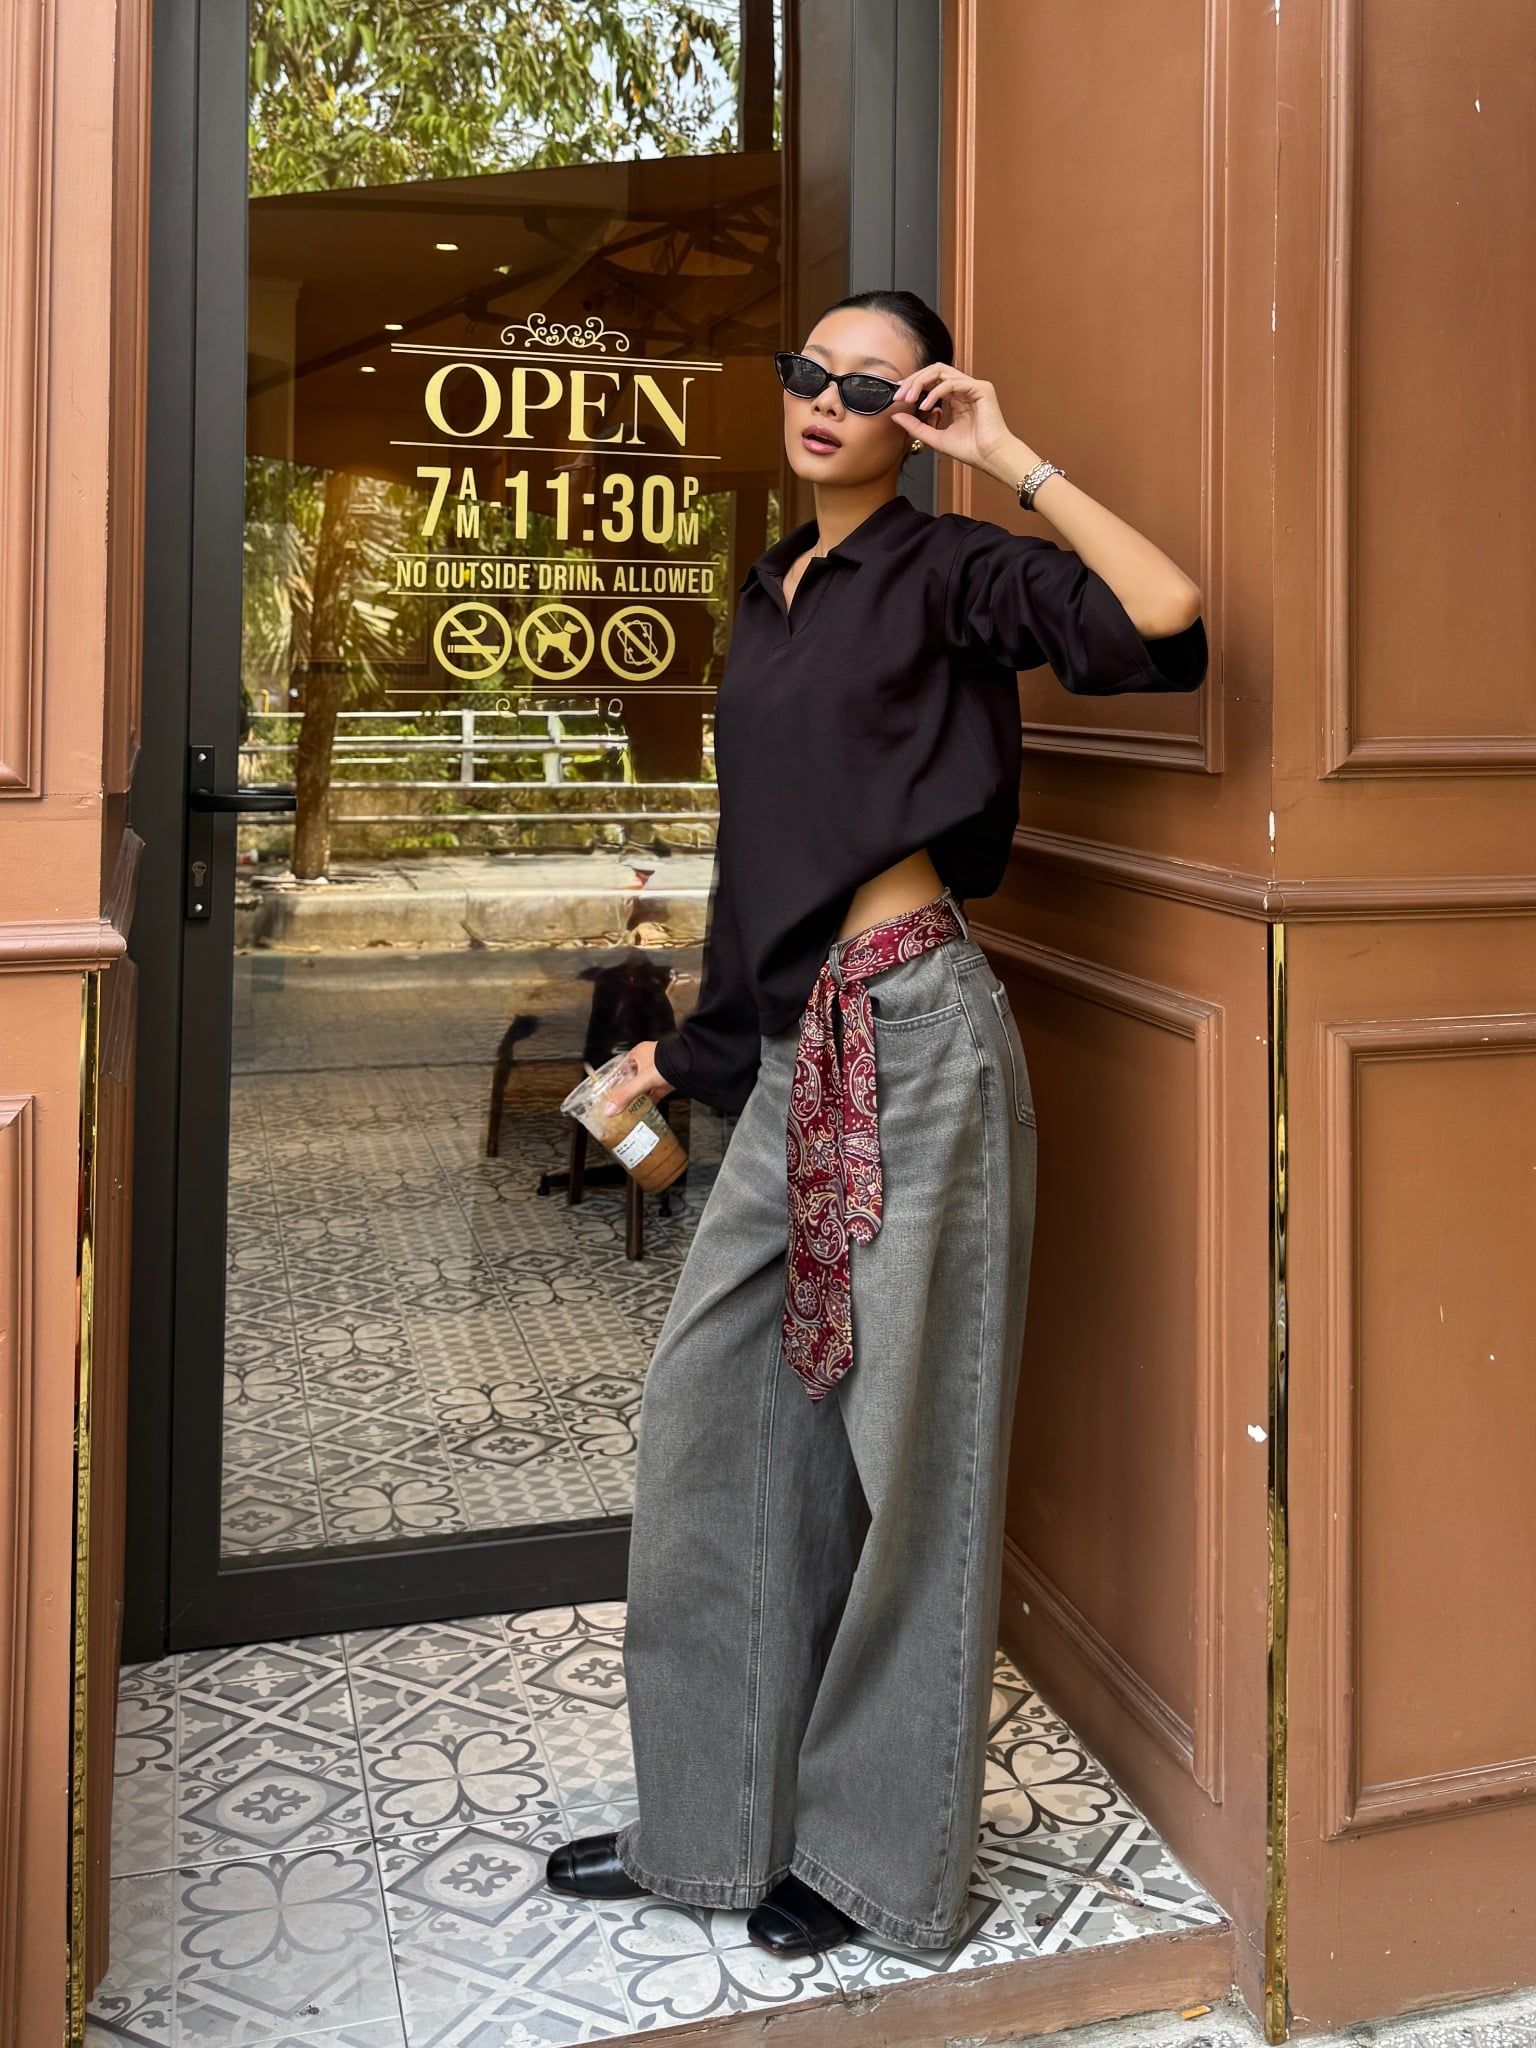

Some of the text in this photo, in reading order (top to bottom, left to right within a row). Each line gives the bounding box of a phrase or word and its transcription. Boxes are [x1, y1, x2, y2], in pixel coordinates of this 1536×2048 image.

[424, 362, 695, 447] OPEN
[396, 560, 427, 589] NO
[435, 561, 531, 590] OUTSIDE
[613, 565, 714, 594] ALLOWED
